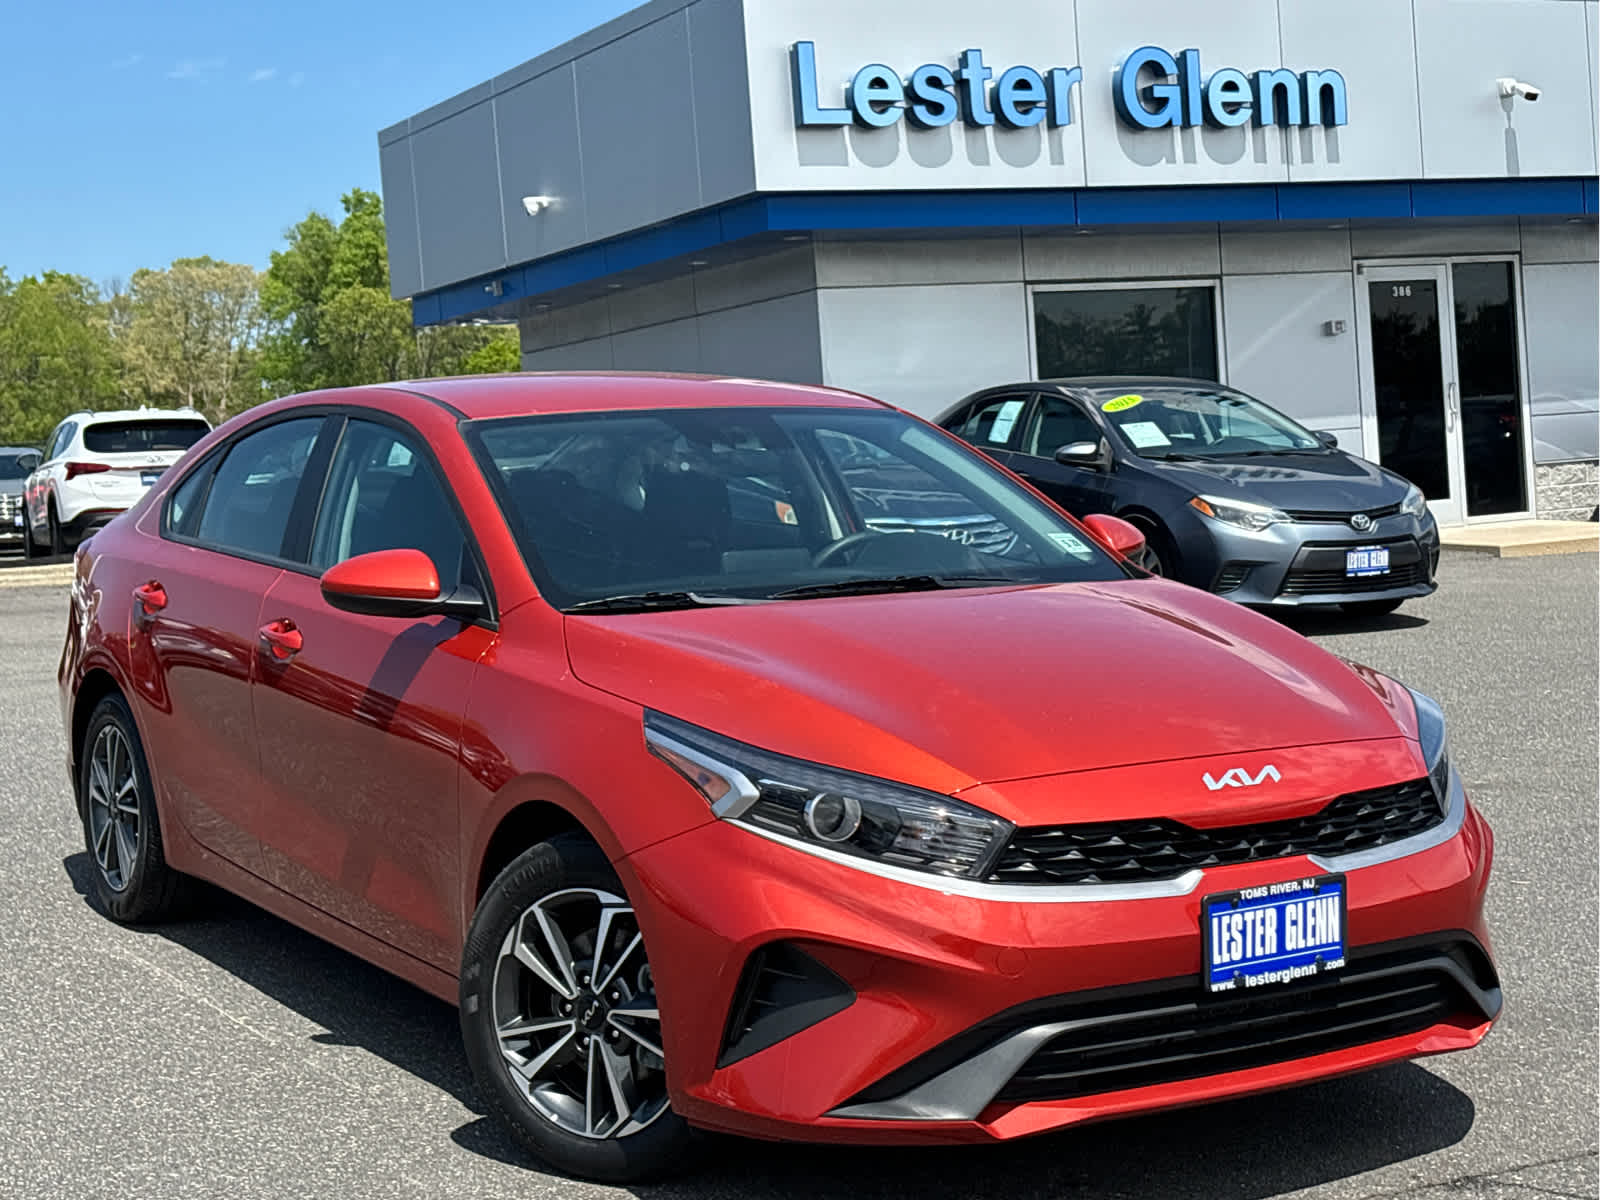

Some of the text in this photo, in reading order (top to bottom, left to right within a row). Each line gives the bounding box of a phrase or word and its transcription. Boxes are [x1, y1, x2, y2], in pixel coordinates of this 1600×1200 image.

[788, 40, 1348, 129] Lester Glenn
[1392, 285, 1412, 297] 386
[1202, 764, 1282, 791] KIA
[1240, 878, 1315, 900] TOMS RIVER, NJ
[1211, 896, 1341, 965] LESTER GLENN
[1245, 964, 1317, 988] lesterglenn
